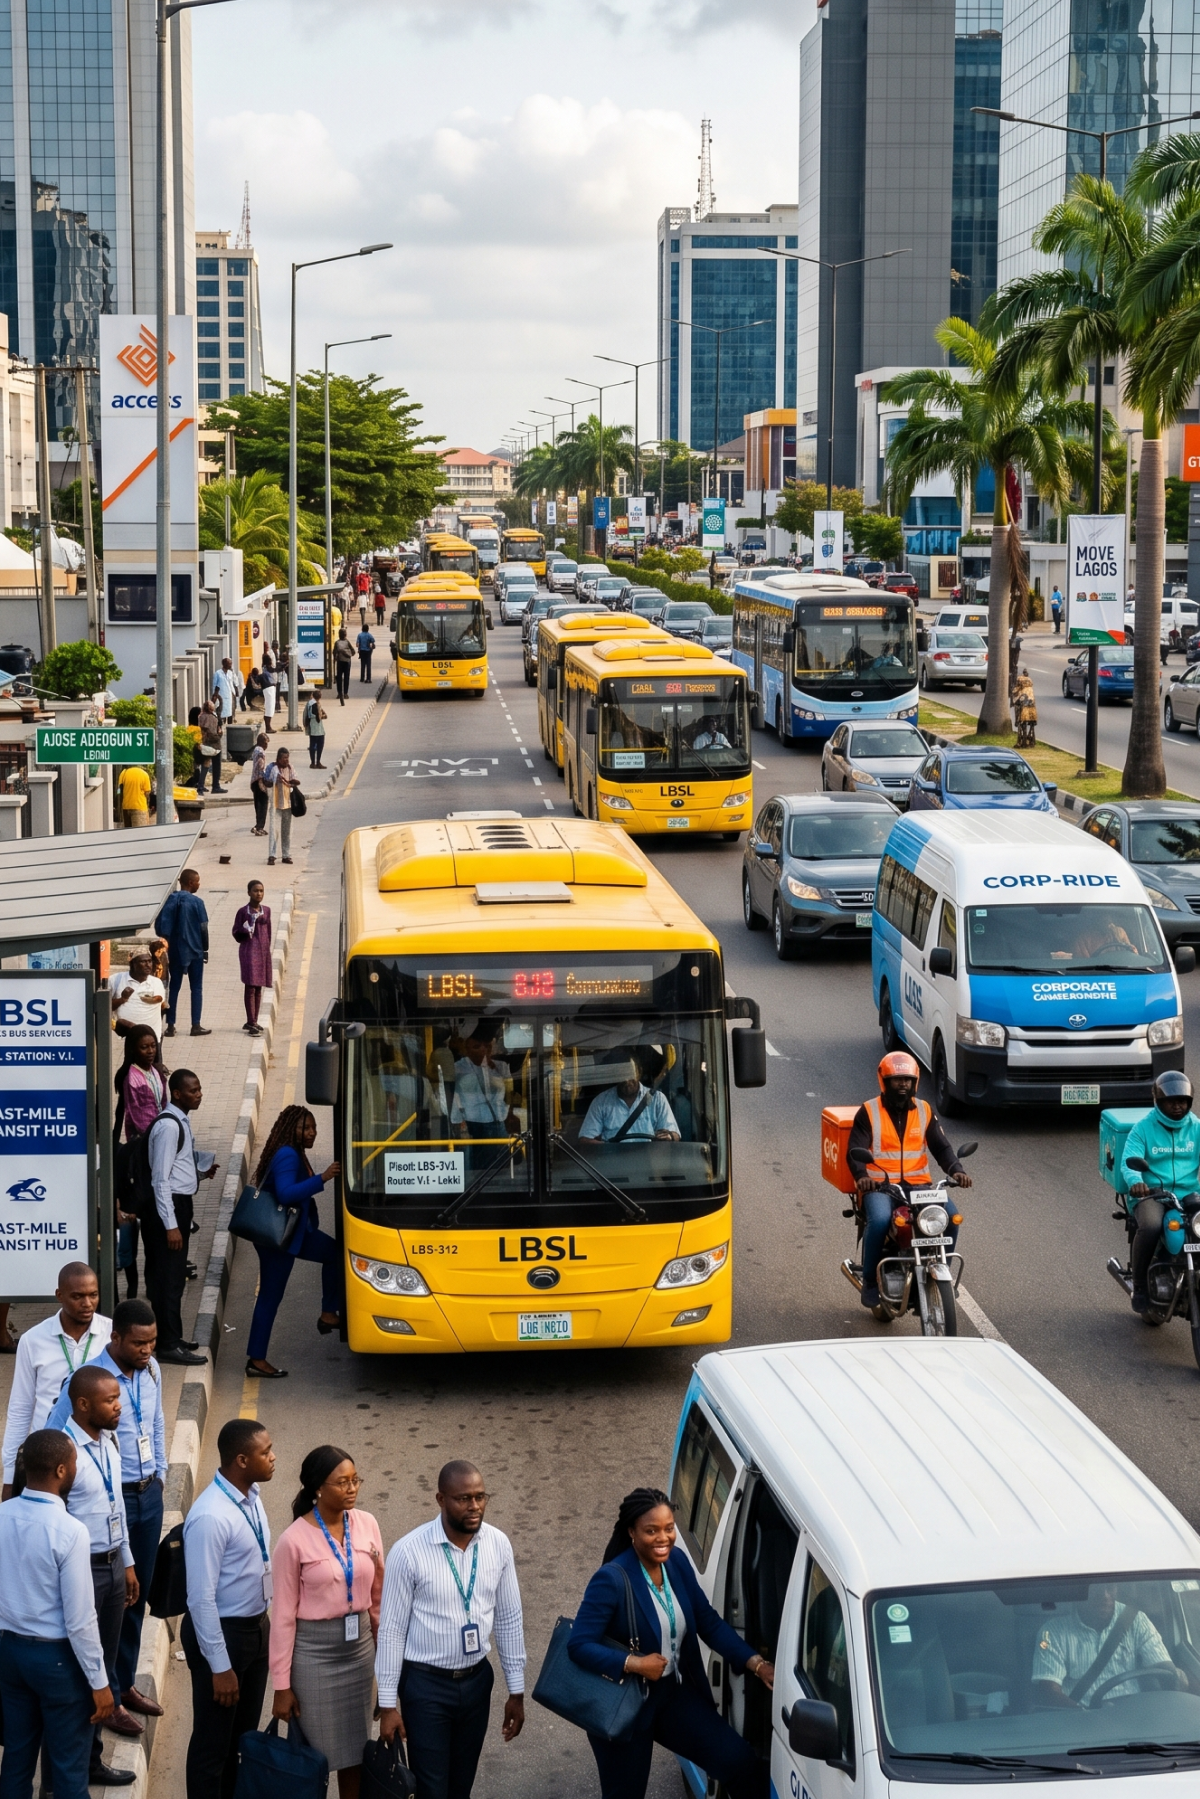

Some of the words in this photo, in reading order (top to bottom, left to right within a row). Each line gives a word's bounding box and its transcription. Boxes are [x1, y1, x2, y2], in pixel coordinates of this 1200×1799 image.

[111, 394, 182, 409] acces
[1076, 545, 1114, 561] MOVE
[1075, 562, 1117, 577] LAGOS
[43, 732, 77, 747] AJOSE
[80, 732, 132, 747] ADEOGUN
[136, 732, 150, 747] ST.
[660, 785, 695, 797] LBSL
[983, 874, 1121, 889] CORP-RIDE
[428, 974, 482, 998] LBSL
[1031, 982, 1117, 993] CORPORATE
[9, 1030, 27, 1038] BUS
[29, 1030, 72, 1038] SERVICES
[5, 1051, 56, 1061] STATION:
[58, 1051, 75, 1061] V.I.
[45, 1124, 78, 1137] HUB
[438, 1175, 461, 1185] Lekki
[45, 1239, 78, 1251] HUB
[411, 1244, 459, 1255] LBS-312
[499, 1235, 588, 1262] LBSL
